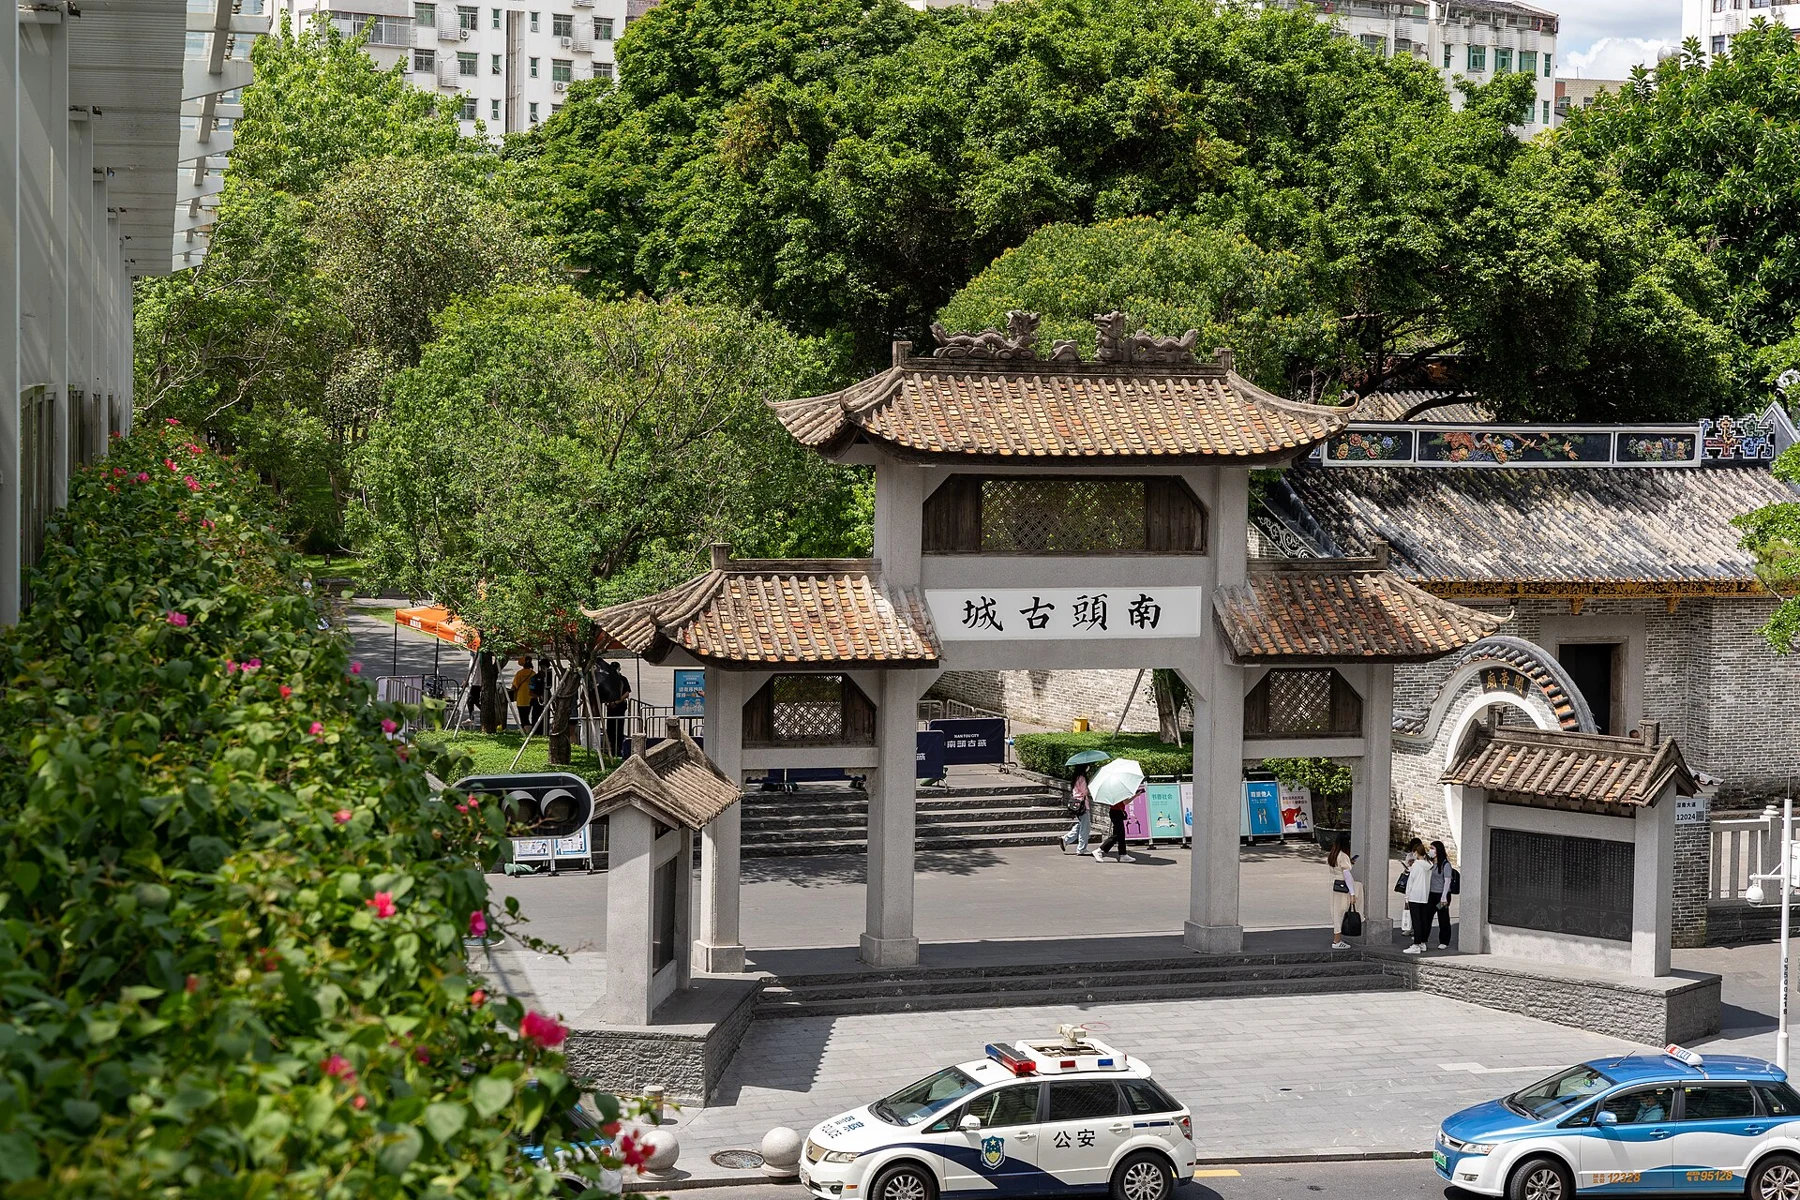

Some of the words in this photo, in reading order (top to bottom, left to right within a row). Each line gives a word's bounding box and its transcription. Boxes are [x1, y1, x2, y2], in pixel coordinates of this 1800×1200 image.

[961, 593, 1162, 632] 南頭古城
[1676, 813, 1696, 821] 12024
[1053, 1128, 1096, 1149] 公安
[1607, 1172, 1641, 1184] 12328
[1700, 1170, 1733, 1182] 95128
